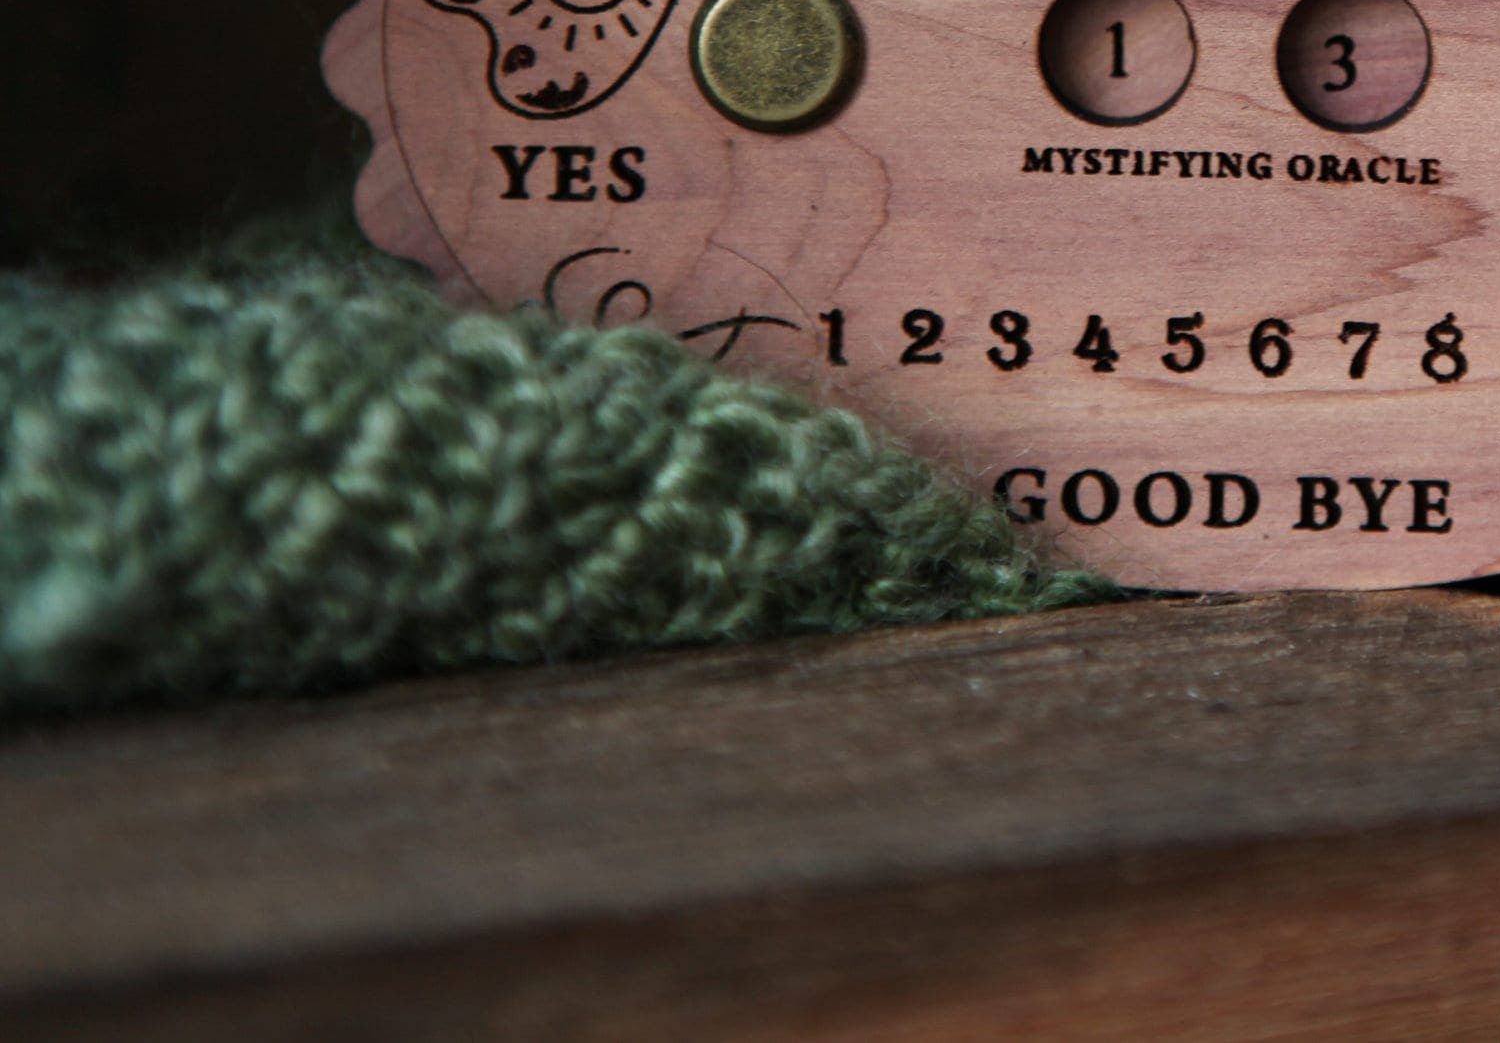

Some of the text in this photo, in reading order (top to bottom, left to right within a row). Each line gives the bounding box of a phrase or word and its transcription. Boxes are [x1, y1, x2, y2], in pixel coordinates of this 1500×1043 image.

[1103, 20, 1357, 94] 1 3
[490, 144, 646, 204] YES
[1021, 146, 1442, 186] MYSTIFYING ORACLE
[819, 308, 848, 367] 1
[899, 308, 945, 367] 2
[986, 309, 1034, 372] 3
[1072, 314, 1120, 374] 4
[1160, 311, 1206, 374] 5
[1247, 317, 1295, 378] 6
[1336, 320, 1381, 380] 7
[1420, 311, 1468, 385] 8
[992, 467, 1453, 535] GOOD BYE
